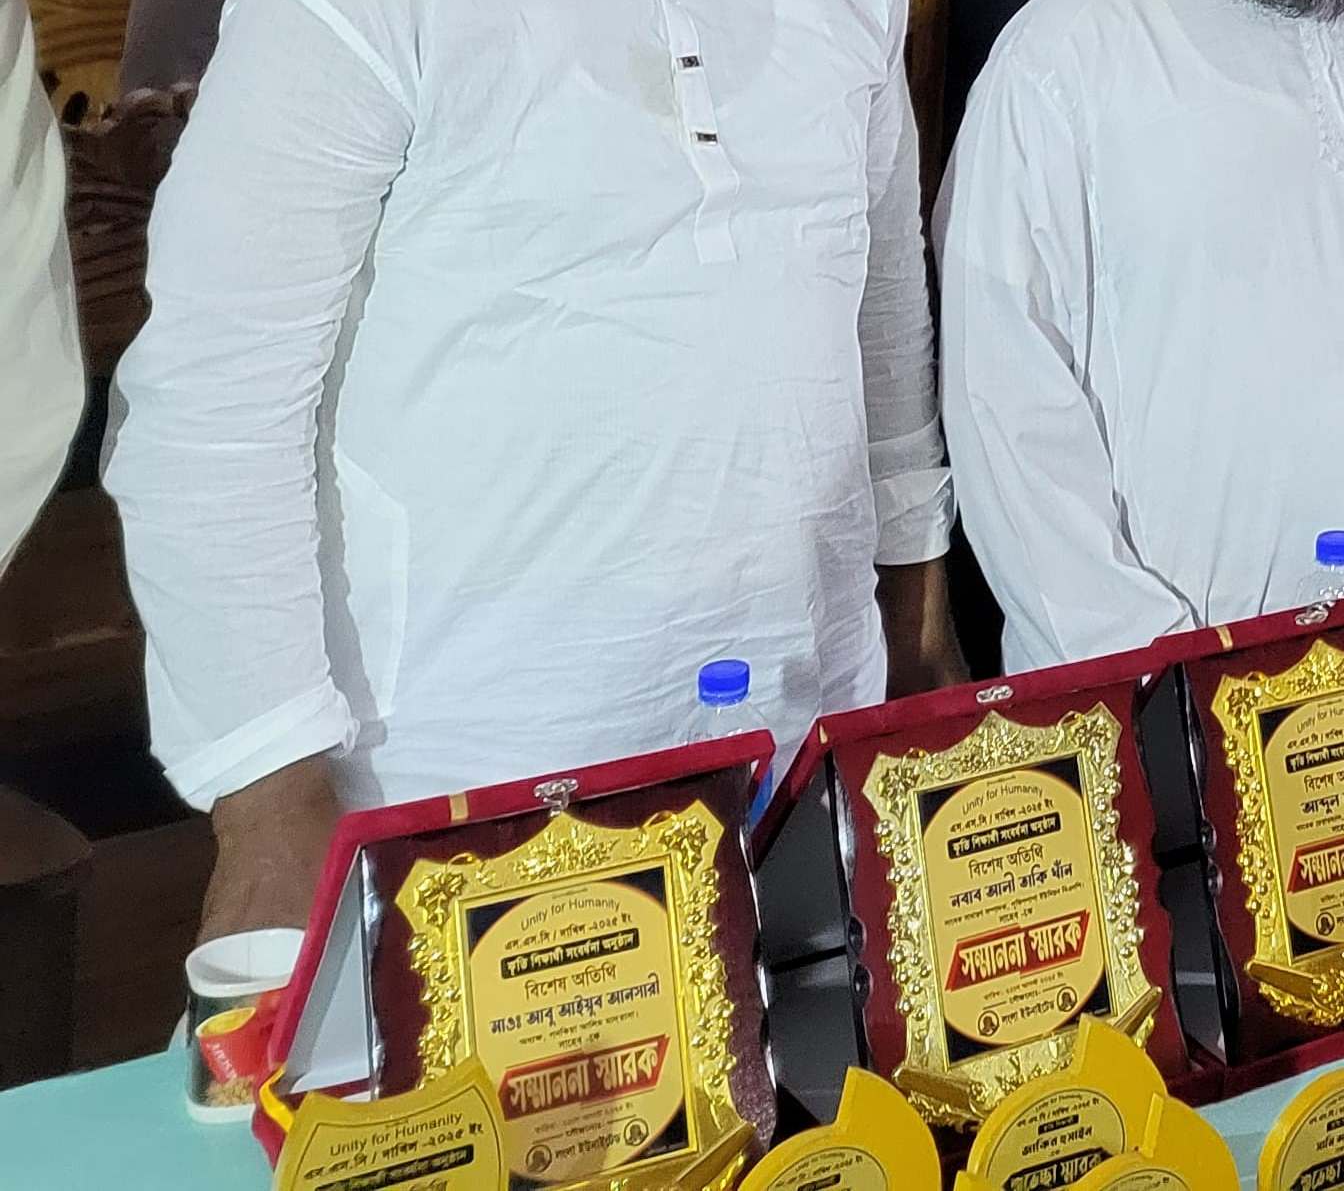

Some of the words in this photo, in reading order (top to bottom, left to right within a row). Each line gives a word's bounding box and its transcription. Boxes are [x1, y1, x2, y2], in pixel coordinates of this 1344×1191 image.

[962, 794, 984, 815] Unity
[987, 790, 999, 800] for
[985, 871, 1016, 898] আলী
[520, 909, 548, 931] Unity
[551, 903, 566, 916] for
[568, 897, 620, 912] Humanity
[525, 979, 567, 1000] বিশেষ
[571, 963, 617, 987] অতিথি
[526, 1007, 557, 1028] আবু
[608, 973, 660, 1005] আনসারী
[507, 1059, 590, 1112] সম্মাননা
[593, 1042, 659, 1091] স্মারক
[330, 1138, 367, 1156] Unity
[372, 1133, 391, 1147] for
[395, 1113, 463, 1139] Humanity
